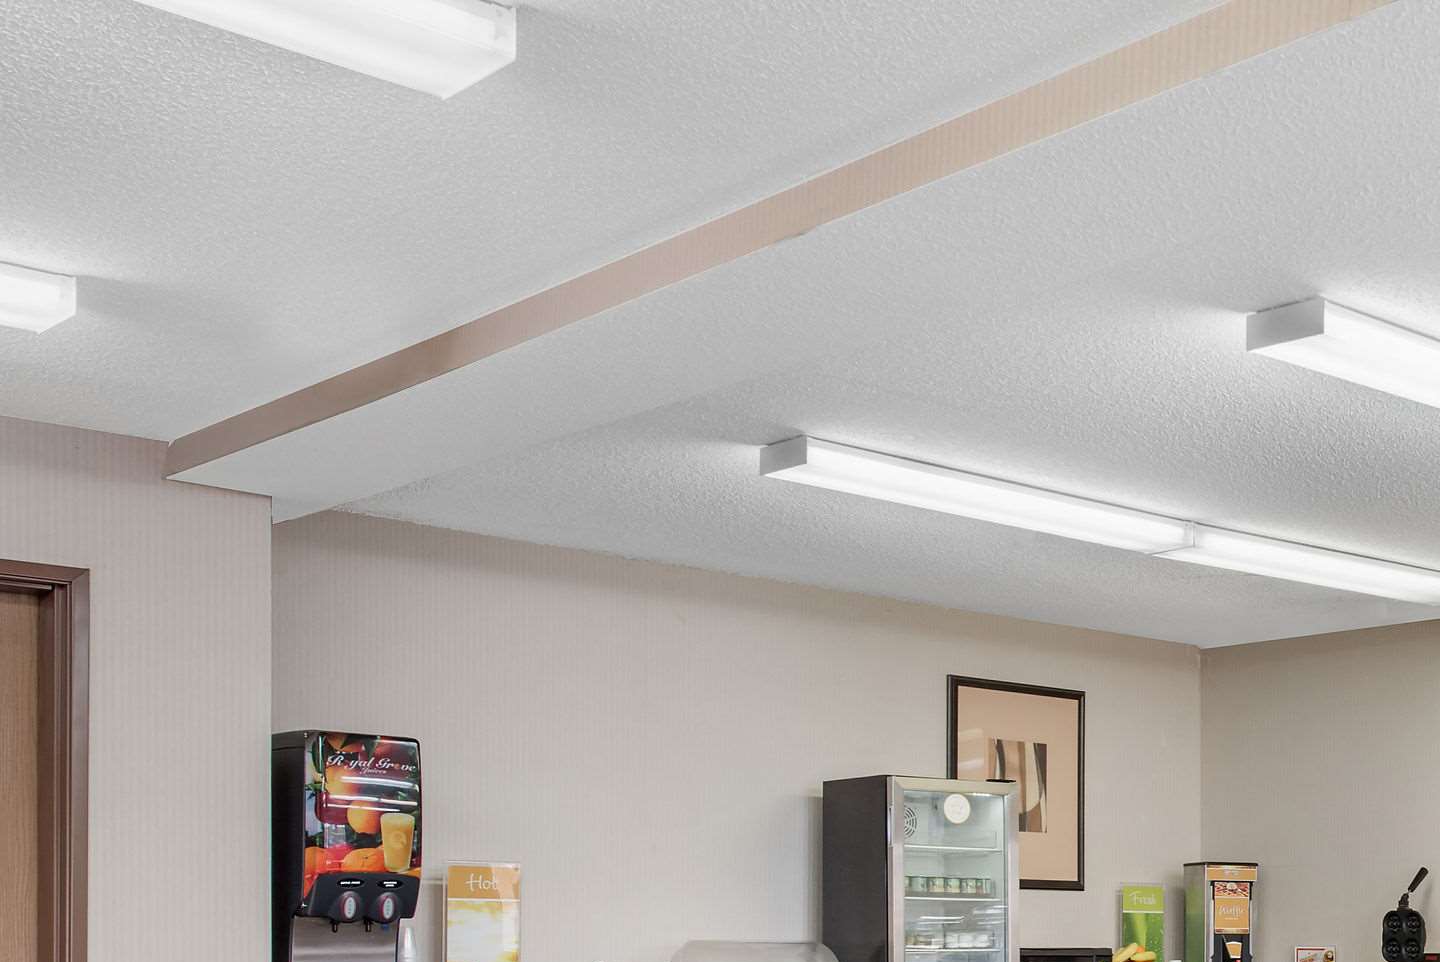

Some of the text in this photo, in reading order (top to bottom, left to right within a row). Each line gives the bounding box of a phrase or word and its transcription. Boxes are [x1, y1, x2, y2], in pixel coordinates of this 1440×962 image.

[326, 754, 416, 772] Ryal Grove
[465, 873, 499, 892] Hot
